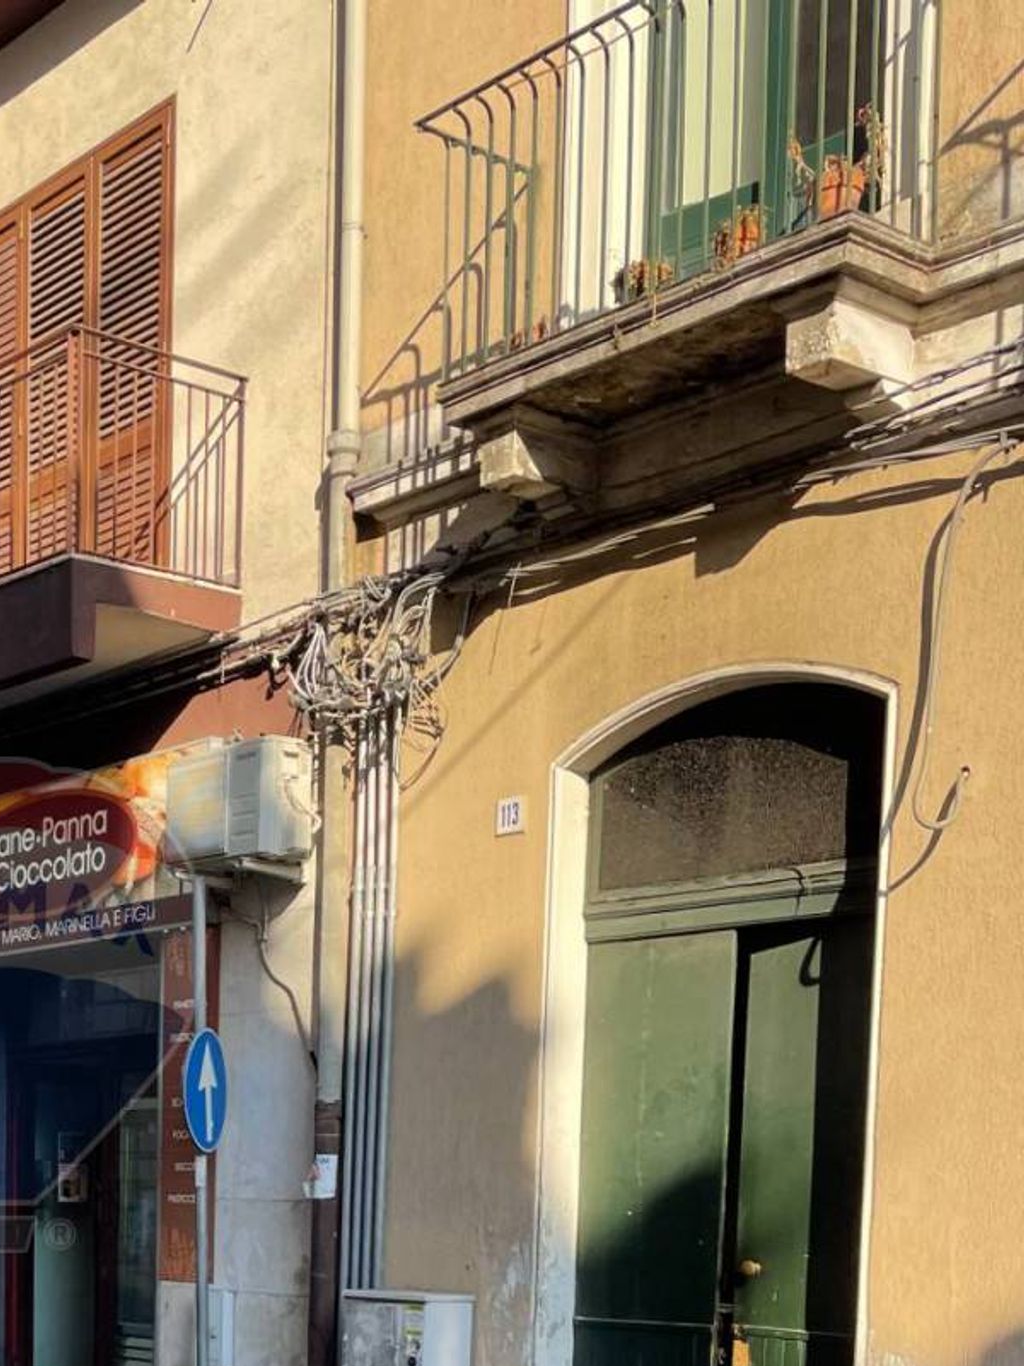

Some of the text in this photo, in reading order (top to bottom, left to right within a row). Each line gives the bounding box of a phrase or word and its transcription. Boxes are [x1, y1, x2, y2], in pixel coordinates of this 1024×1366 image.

[501, 802, 519, 828] 113
[45, 912, 111, 938] MARINELLA
[113, 909, 122, 927] E
[124, 902, 155, 924] FIGLI
